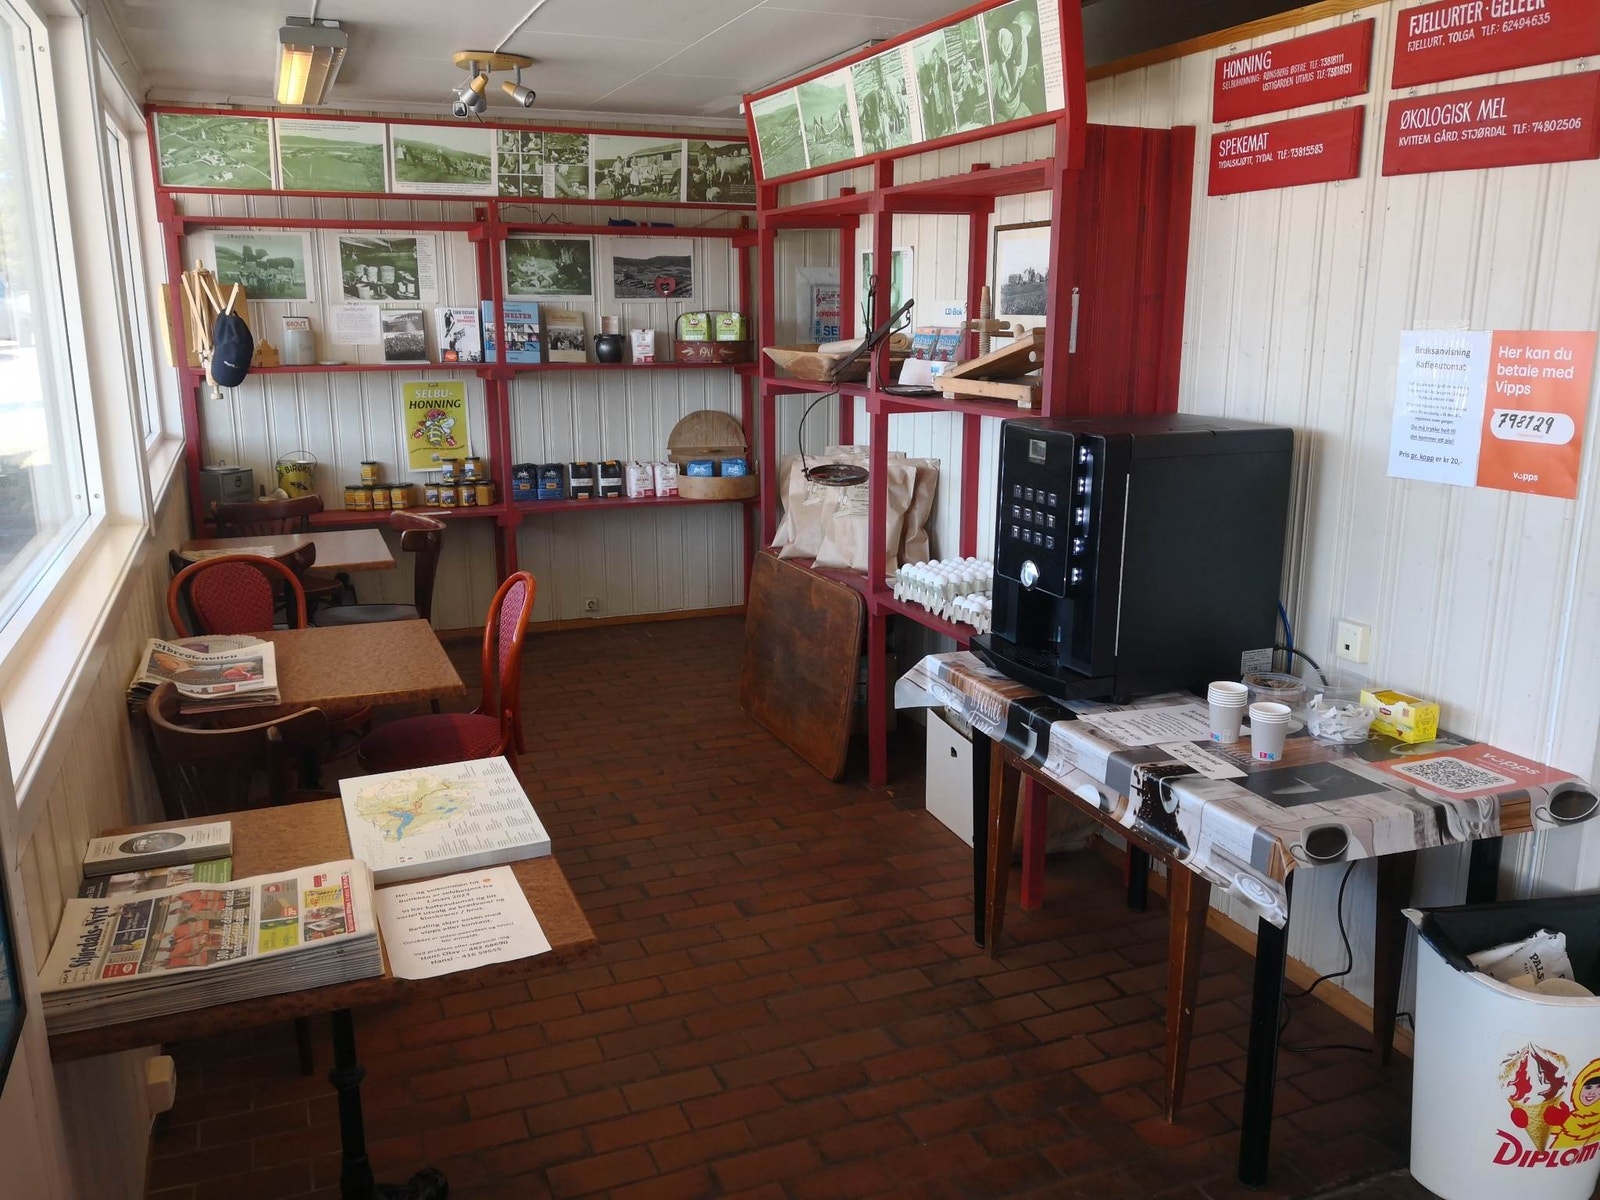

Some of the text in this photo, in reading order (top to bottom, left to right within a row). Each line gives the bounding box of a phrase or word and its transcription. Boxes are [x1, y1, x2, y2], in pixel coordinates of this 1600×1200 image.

[1409, 1, 1482, 36] FJELLURTER
[1448, 28, 1475, 43] TOLGA
[1502, 12, 1550, 32] 62494635
[1223, 51, 1272, 79] HONNING
[1290, 62, 1307, 75] ØSTRE
[1400, 97, 1507, 130] ØKOLOGISK MEL
[1399, 134, 1431, 147] KVITTEM
[1461, 125, 1507, 139] STJØRDAL
[1532, 117, 1582, 133] 74802506
[1219, 133, 1269, 157] SPEKEMAT
[1255, 154, 1274, 164] TYDAL
[1290, 143, 1323, 158] 73815583
[1415, 346, 1471, 358] Bruksanvisning
[1498, 345, 1573, 361] Her kan du
[1415, 360, 1466, 372] Kaffeautomat
[1497, 362, 1574, 379] betale med
[415, 389, 453, 398] SELBU-
[1495, 380, 1532, 396] Vipps
[409, 399, 461, 409] HONNING
[1420, 453, 1434, 463] kopp
[425, 897, 474, 909] kaffeautomat
[420, 910, 458, 920] kioskvarer
[408, 922, 439, 932] Betaling
[68, 906, 109, 967] Stjørdals-Nytt
[1529, 953, 1544, 980] PALS
[1492, 1129, 1599, 1168] DIPLOM
